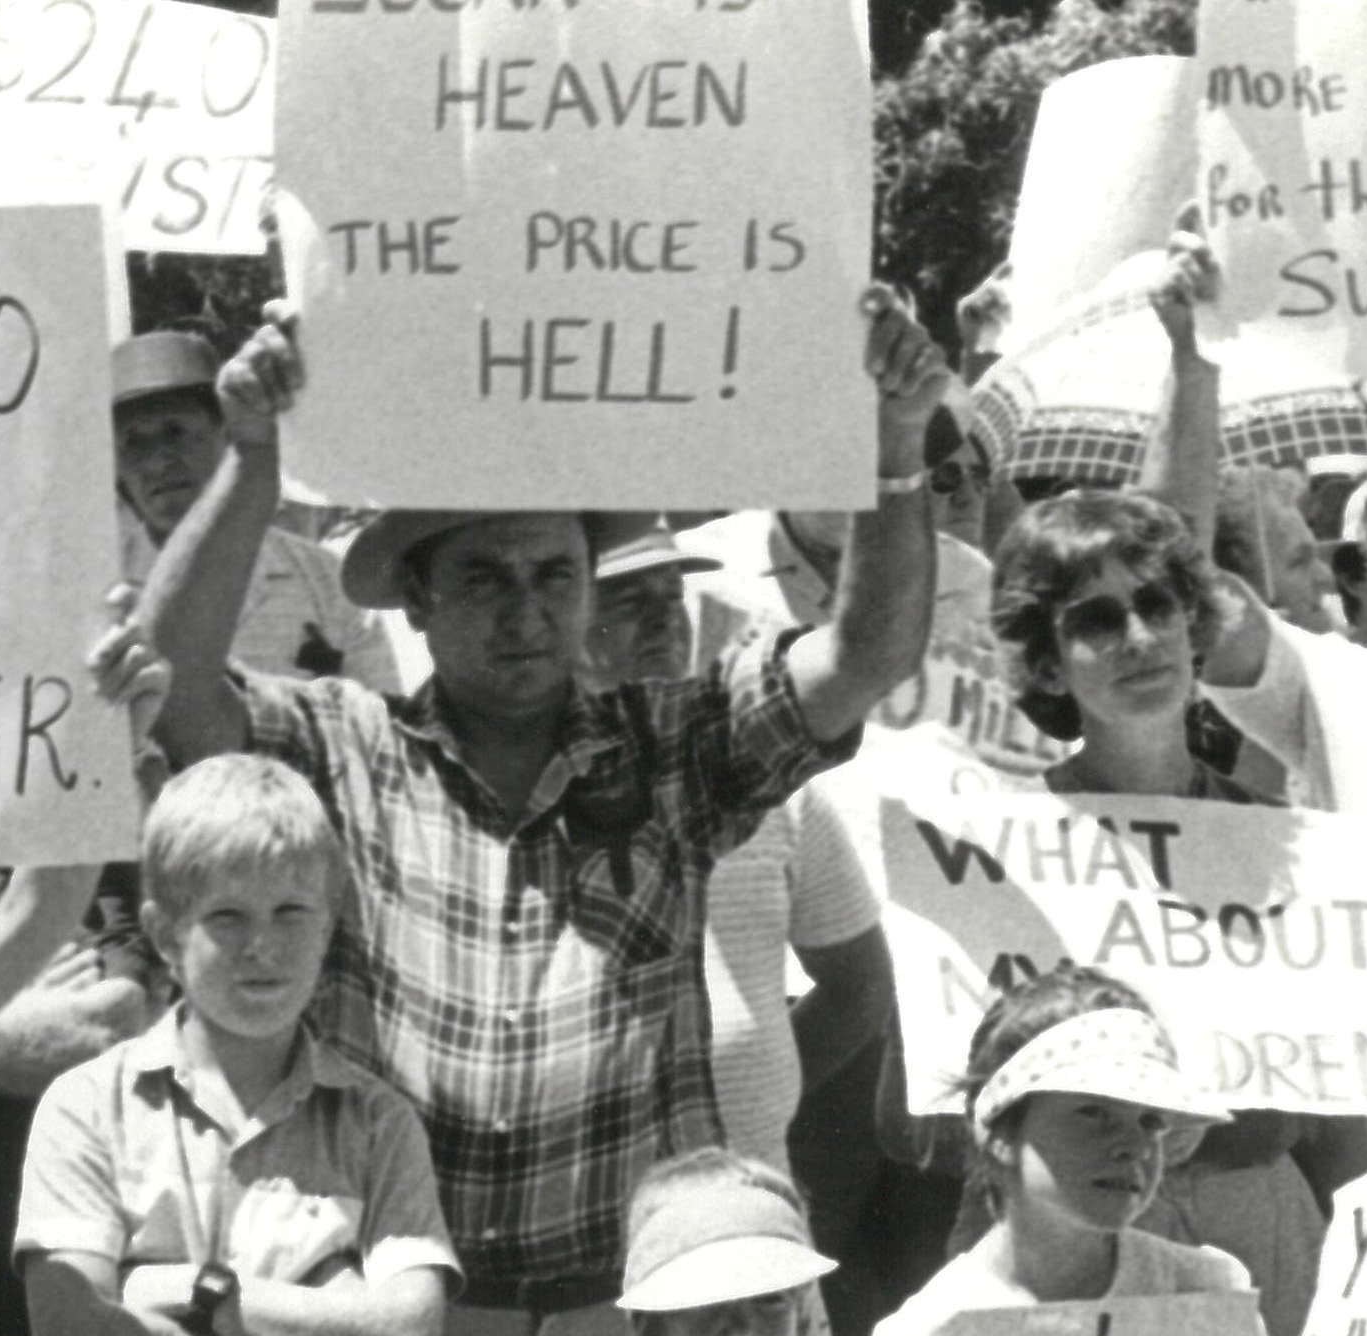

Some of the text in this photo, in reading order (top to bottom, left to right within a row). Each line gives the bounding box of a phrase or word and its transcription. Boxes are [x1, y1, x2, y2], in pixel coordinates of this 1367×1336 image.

[435, 56, 747, 132] HEAVEN
[328, 211, 806, 276] THE PRICE IS
[915, 816, 1180, 889] WHAT
